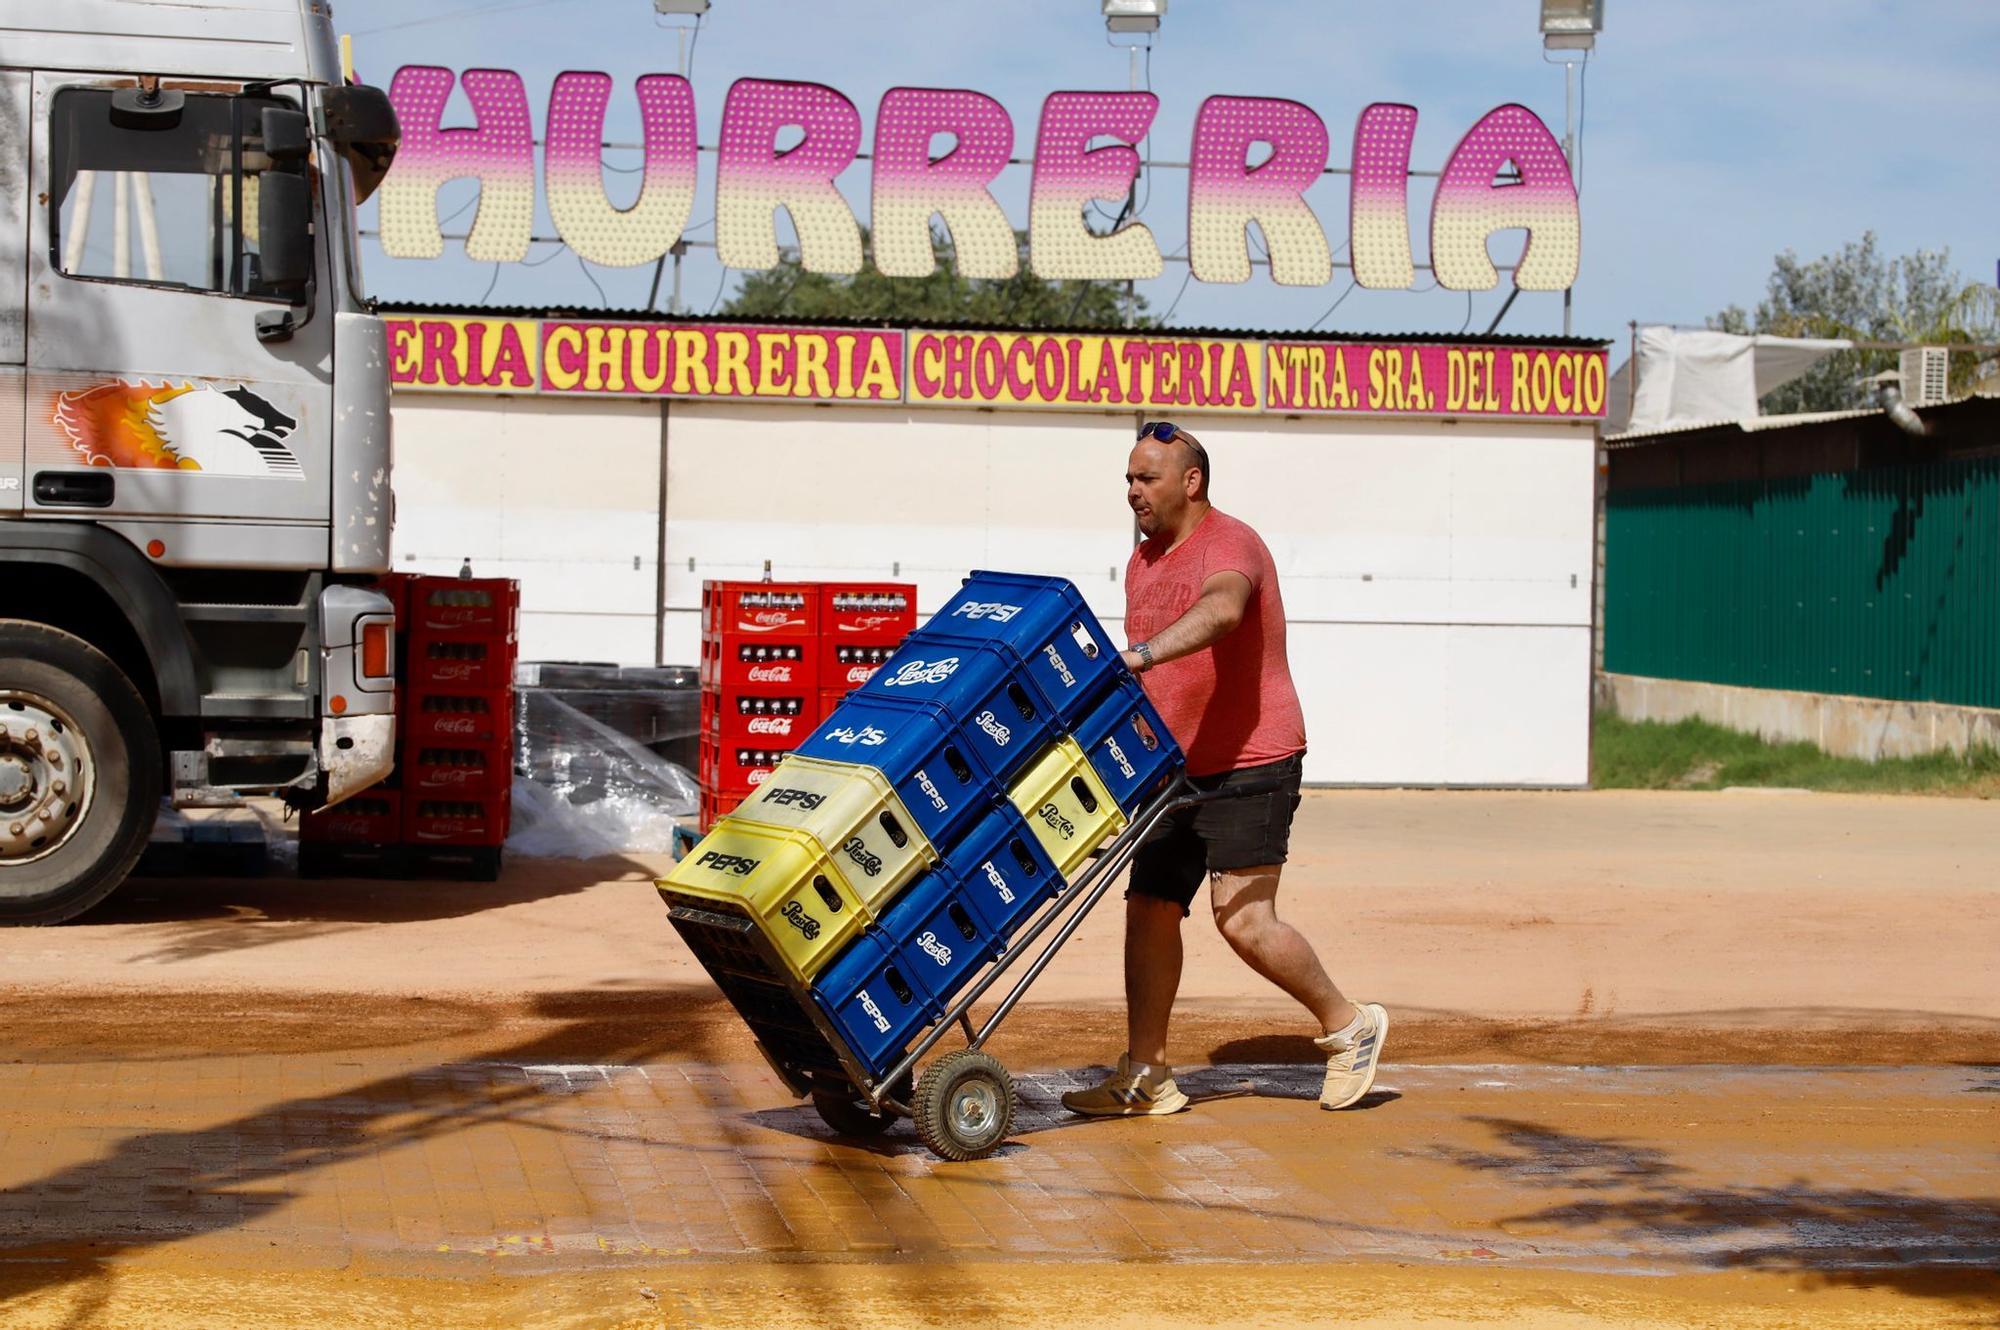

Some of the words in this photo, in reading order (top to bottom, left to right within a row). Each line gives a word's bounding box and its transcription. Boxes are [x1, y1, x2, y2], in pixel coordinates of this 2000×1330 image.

[353, 66, 1580, 291] HURRERIA
[386, 319, 534, 387] ERIA
[543, 324, 902, 399] CHURRERIA
[913, 333, 1256, 407] CHOCOLATERIA
[1267, 345, 1359, 409] NTRA.
[1368, 346, 1434, 411] SRA.
[1446, 348, 1501, 412] DEL
[1510, 351, 1606, 415] ROCIO
[952, 601, 1023, 623] PEPSI
[748, 666, 792, 682] Coca-Cola
[1042, 643, 1077, 688] PEPSI
[748, 717, 793, 735] Coca-Cola
[1104, 736, 1136, 780] PEPSI
[762, 788, 827, 811] PEPSI
[914, 769, 949, 813] PEPSI
[696, 851, 761, 875] PEPSI
[981, 861, 1016, 905] PEPSI
[856, 989, 892, 1033] PEPSI
